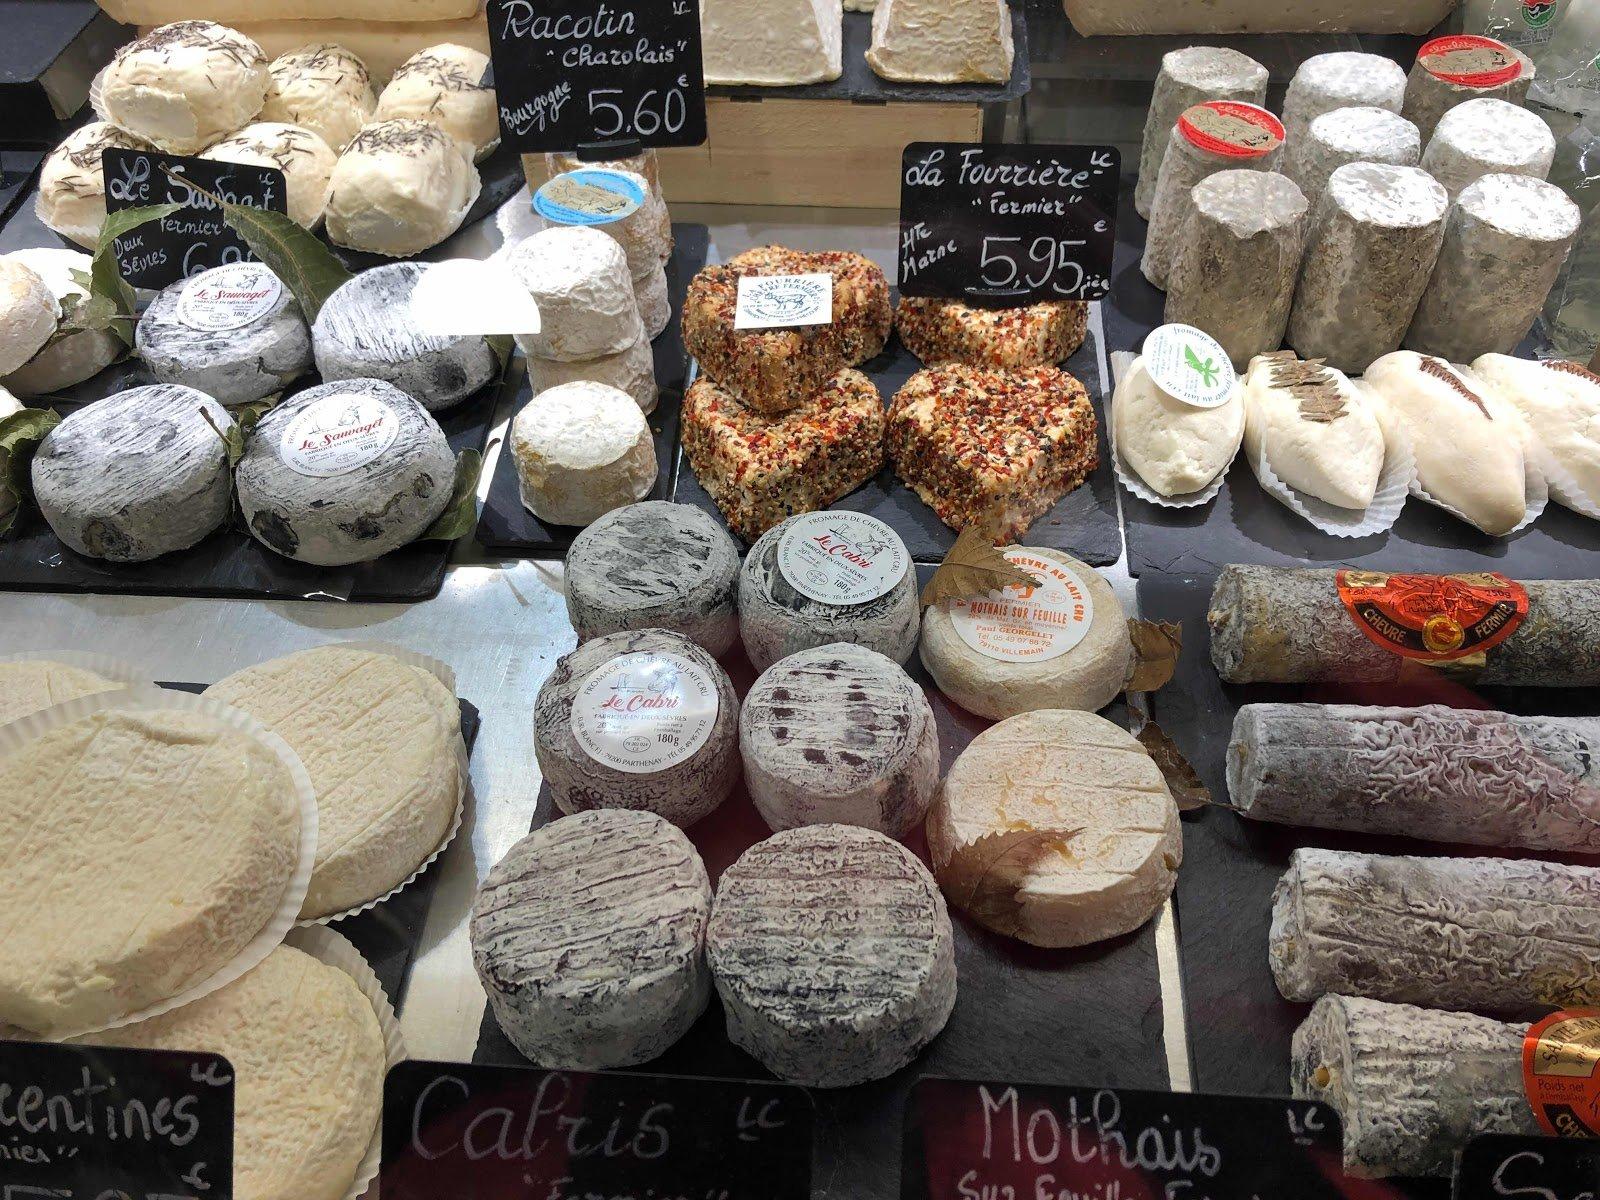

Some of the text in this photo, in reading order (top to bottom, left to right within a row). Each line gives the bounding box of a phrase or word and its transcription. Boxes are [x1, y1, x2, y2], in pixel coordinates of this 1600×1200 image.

[501, 0, 635, 40] Racotin
[501, 81, 571, 136] Bourgogne
[110, 156, 150, 201] Le
[906, 149, 1091, 189] La Fourrière
[113, 236, 144, 260] Deux
[903, 239, 957, 283] Marne
[193, 289, 209, 300] Le
[298, 440, 319, 451] Le
[320, 417, 384, 447] Sauvaget
[808, 514, 848, 526] FROMAGE
[813, 535, 831, 550] Le
[828, 544, 874, 569] Cabri
[1050, 568, 1067, 580] AU
[970, 601, 1008, 617] MOTHAIS
[1011, 606, 1029, 619] SUR
[1032, 608, 1068, 625] FEUILLE
[976, 624, 1054, 639] Paul GEORGELET
[1001, 646, 1044, 656] VILLEMAIN
[584, 663, 620, 696] FROMAGE
[602, 694, 680, 712] Le Cabri
[656, 733, 680, 747] 180g
[621, 757, 663, 767] PARTHENAY
[979, 1085, 1222, 1177] Mothais
